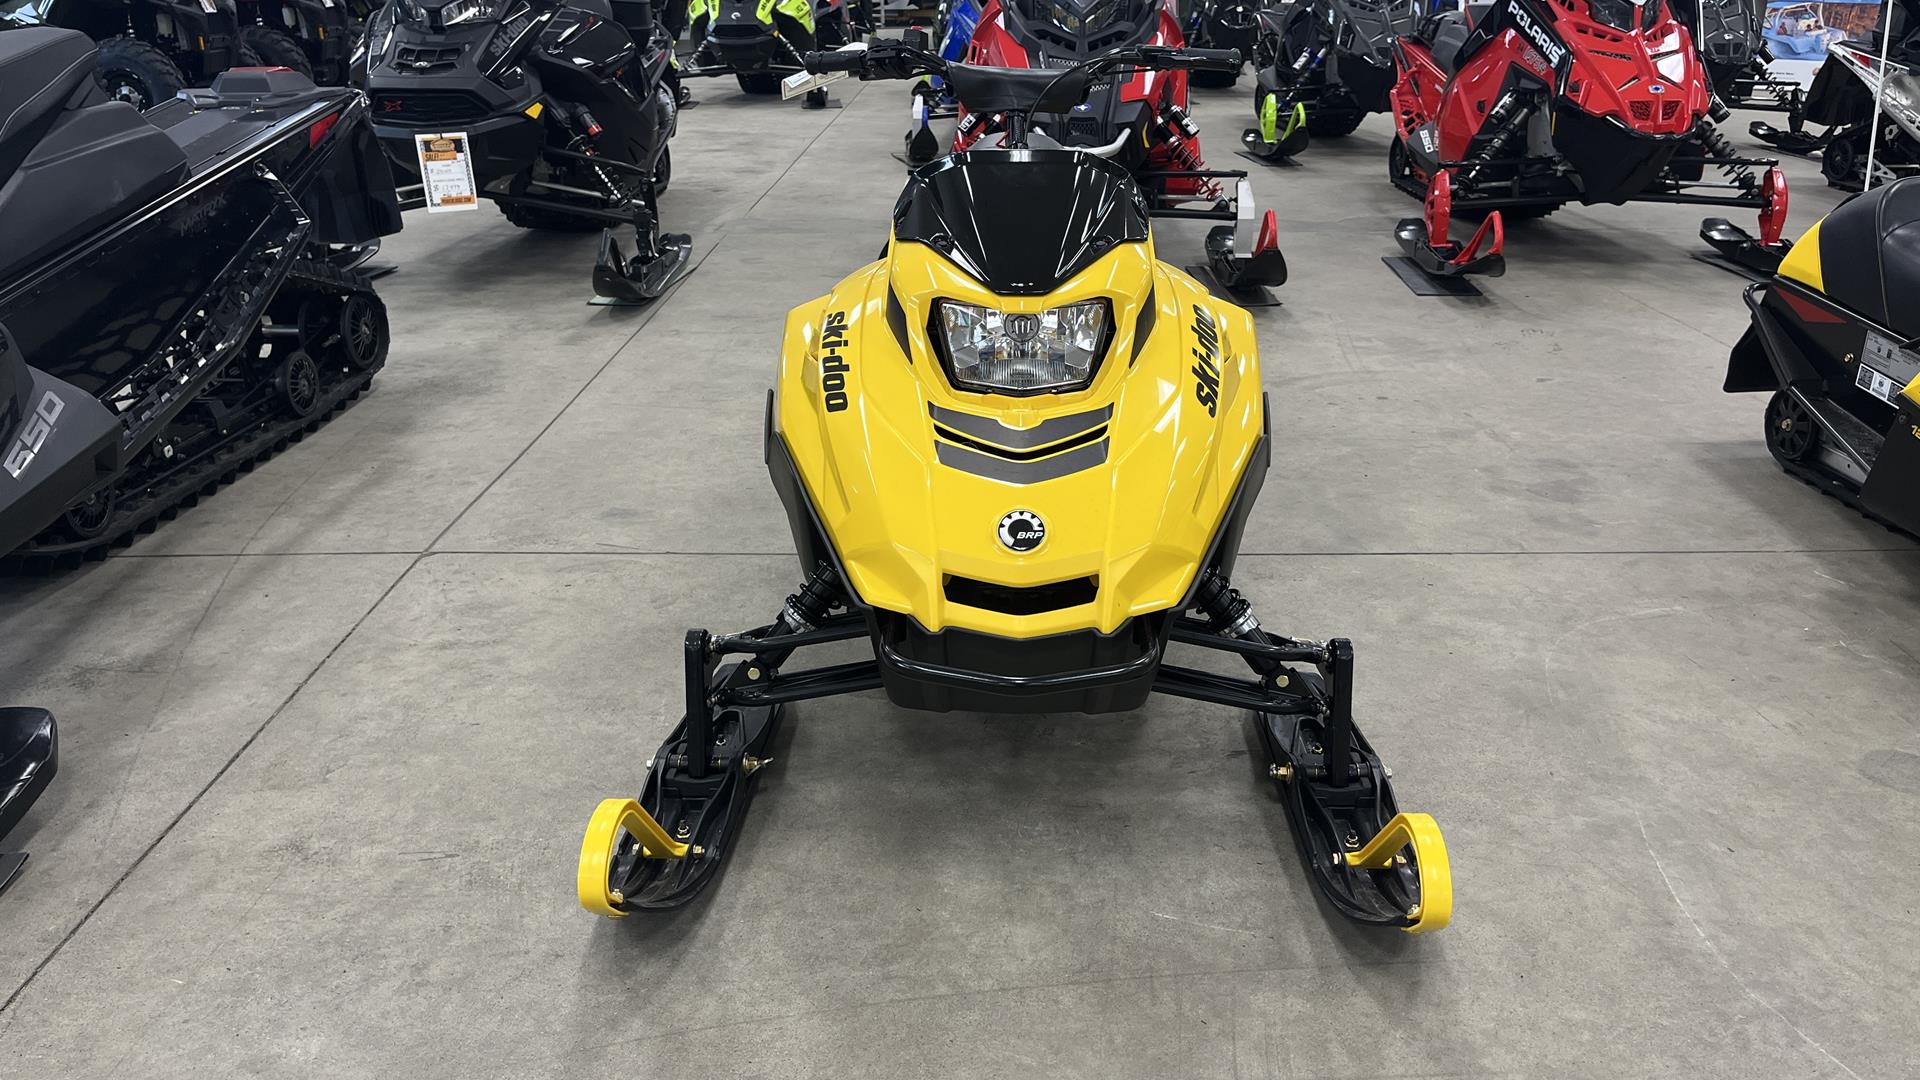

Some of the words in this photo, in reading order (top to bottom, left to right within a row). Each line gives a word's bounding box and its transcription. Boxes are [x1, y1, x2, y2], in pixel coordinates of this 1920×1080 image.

[490, 16, 529, 56] ski-doo
[1507, 1, 1566, 69] POLARIS
[1420, 130, 1435, 153] 850
[822, 311, 850, 413] ski-doo
[1191, 303, 1220, 418] ski-doo
[3, 390, 66, 479] 650
[1016, 531, 1043, 539] BRP
